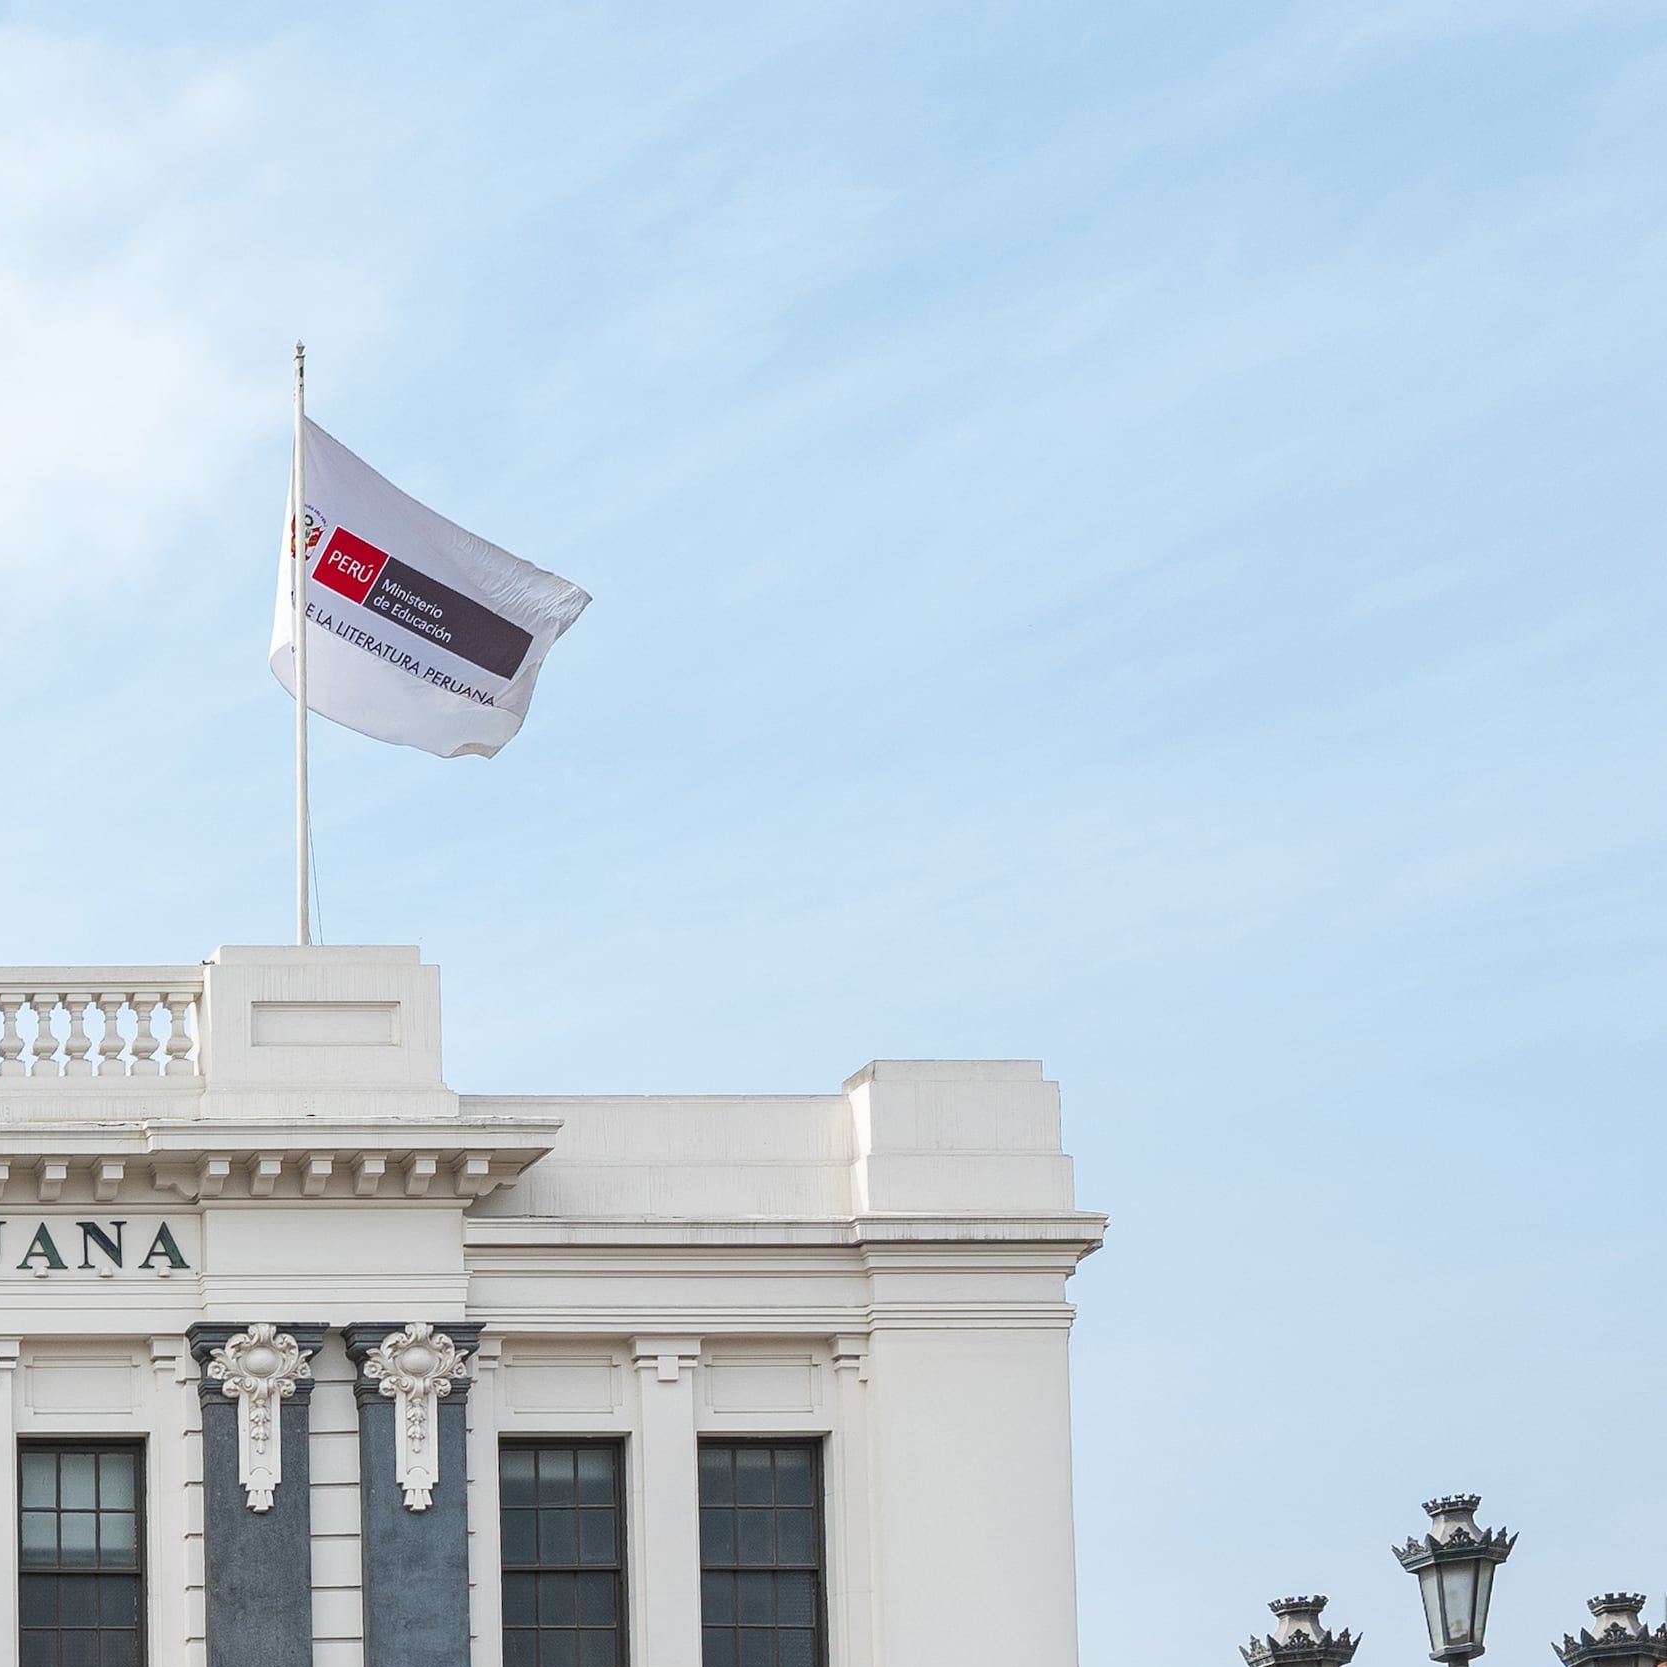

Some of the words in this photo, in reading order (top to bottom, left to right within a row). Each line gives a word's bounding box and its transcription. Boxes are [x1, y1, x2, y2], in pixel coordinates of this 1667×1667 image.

[328, 549, 375, 583] PERÚ
[373, 595, 390, 611] de
[390, 603, 452, 643] Educación
[381, 578, 443, 619] Ministerio
[316, 609, 332, 631] LA
[335, 620, 421, 675] LITERATURA
[423, 666, 495, 707] PERUANA
